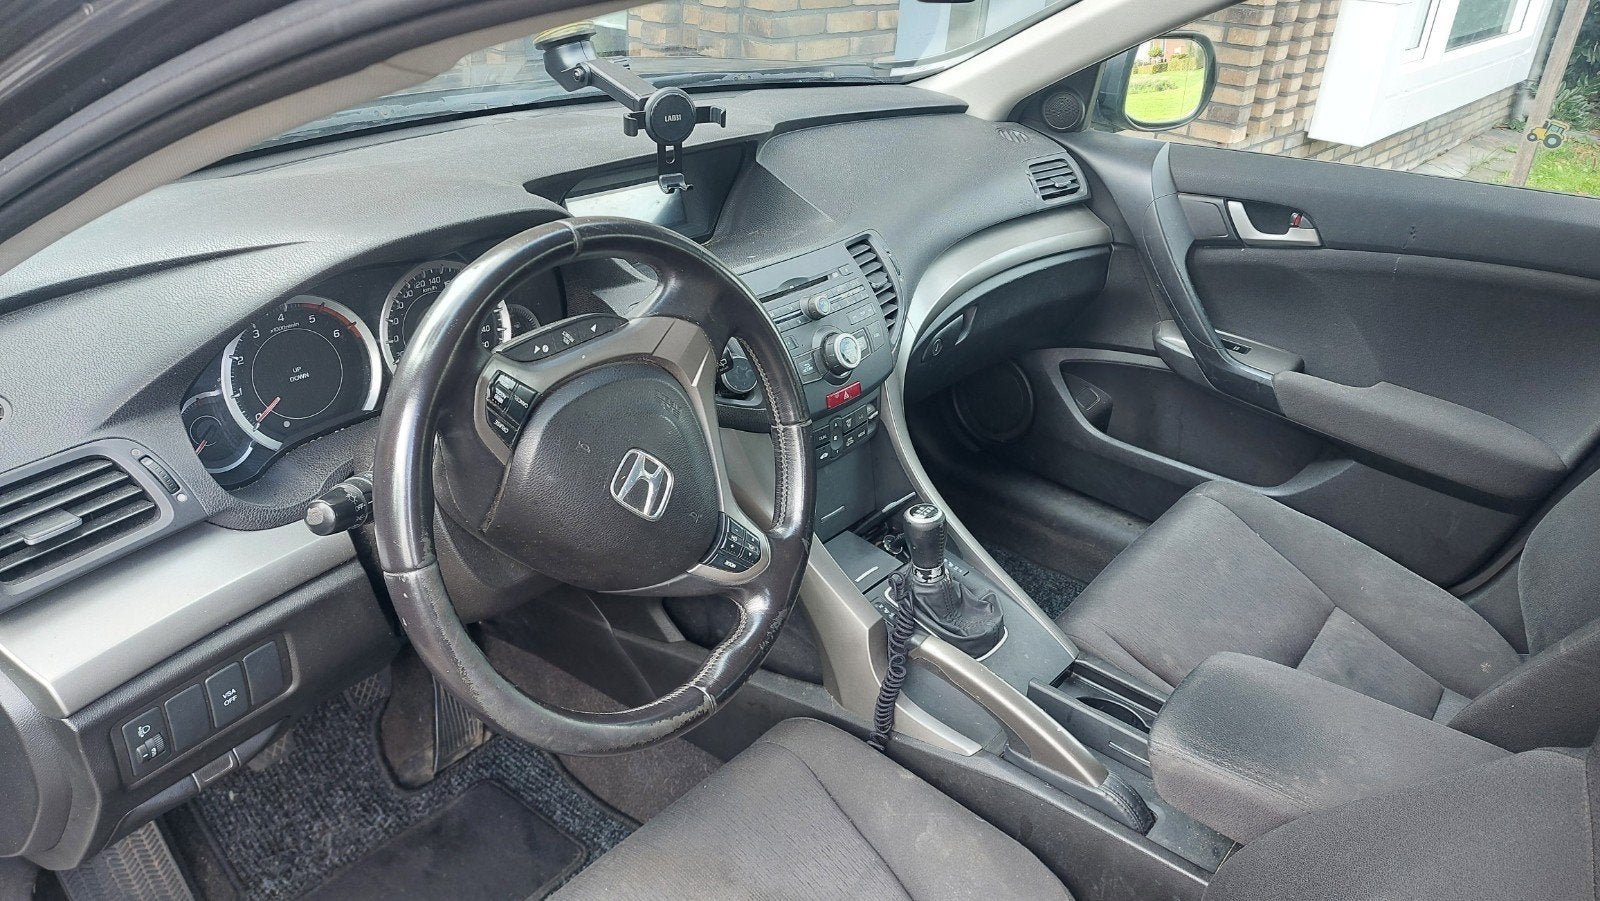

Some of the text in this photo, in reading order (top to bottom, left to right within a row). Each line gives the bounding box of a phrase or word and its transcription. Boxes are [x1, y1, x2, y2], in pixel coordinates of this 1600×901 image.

[428, 276, 441, 285] 140
[277, 313, 285, 322] 4
[308, 314, 316, 323] 5
[252, 329, 260, 338] 3
[333, 329, 341, 338] 6
[237, 356, 244, 365] 2
[289, 372, 310, 383] DOWN
[223, 695, 238, 706] OFF
